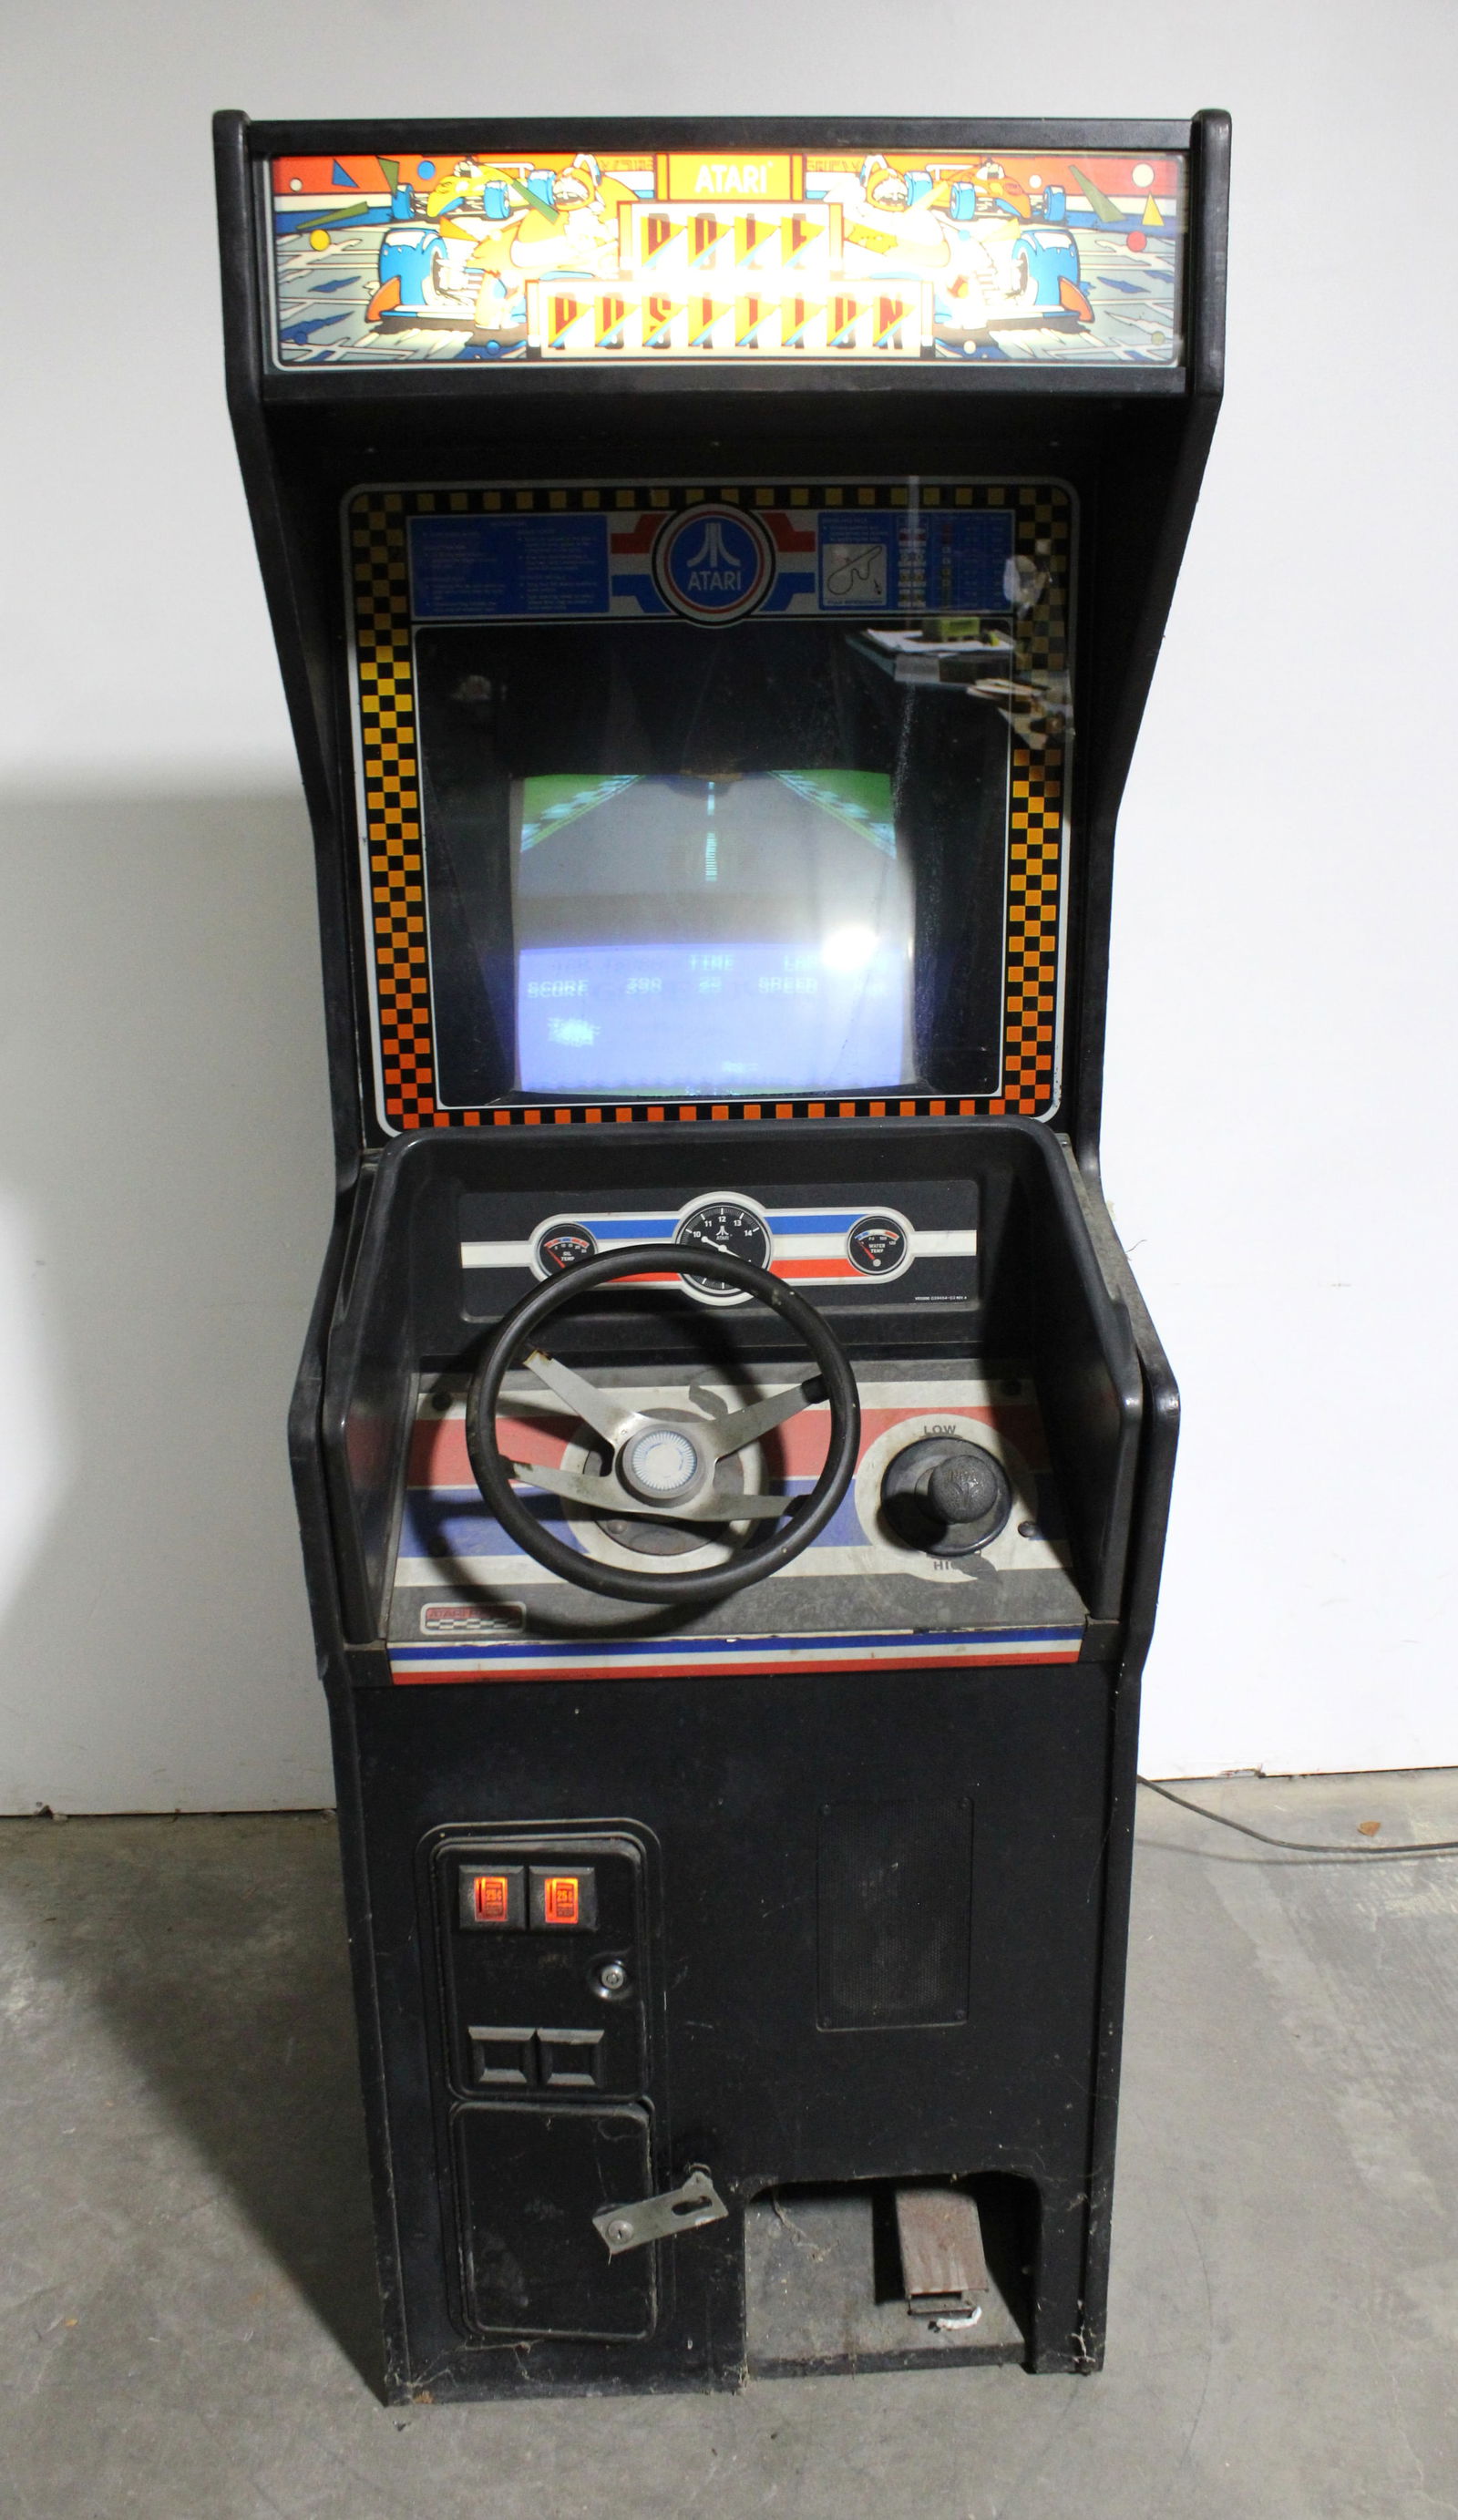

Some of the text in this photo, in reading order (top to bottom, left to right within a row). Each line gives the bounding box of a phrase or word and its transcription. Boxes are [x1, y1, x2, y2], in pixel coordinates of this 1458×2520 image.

[693, 164, 768, 194] ATARI
[687, 571, 743, 591] ATARI
[528, 978, 590, 999] SCORE
[924, 1425, 957, 1436] LOW
[933, 1560, 953, 1571] HI
